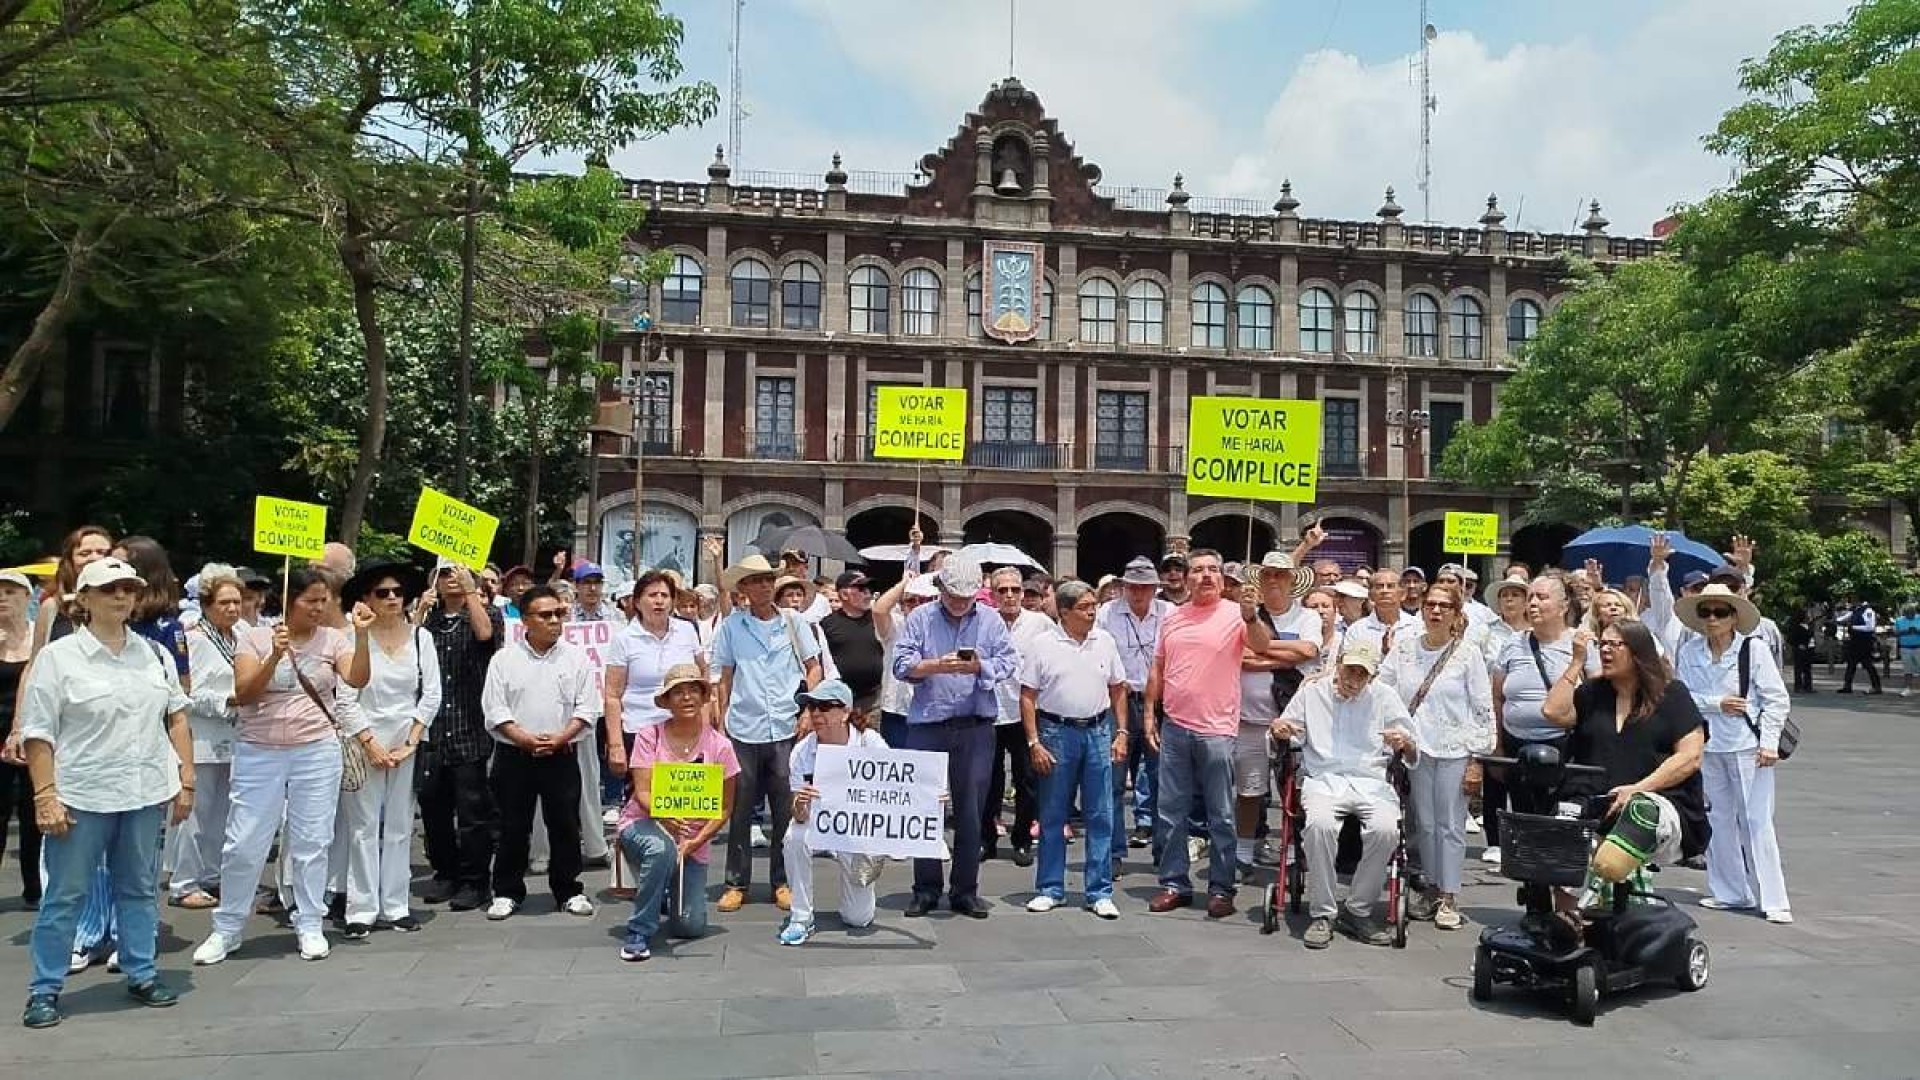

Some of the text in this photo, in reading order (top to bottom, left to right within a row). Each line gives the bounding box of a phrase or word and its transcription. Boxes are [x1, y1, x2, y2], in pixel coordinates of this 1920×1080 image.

[899, 395, 944, 410] VOTAR
[1222, 408, 1287, 430] VOTAR
[879, 429, 961, 449] COMPLICE
[1222, 436, 1240, 450] ME
[1193, 457, 1311, 487] COMPLICE
[274, 505, 308, 520] VOTAR
[443, 503, 476, 525] VOTAR
[259, 530, 321, 551] COMPLICE
[420, 524, 480, 560] COMPLICE
[670, 769, 705, 781] VOTAR
[848, 759, 915, 783] VOTAR
[654, 796, 718, 811] COMPLICE
[847, 786, 911, 806] ME HARÍA
[816, 810, 939, 841] COMPLICE
